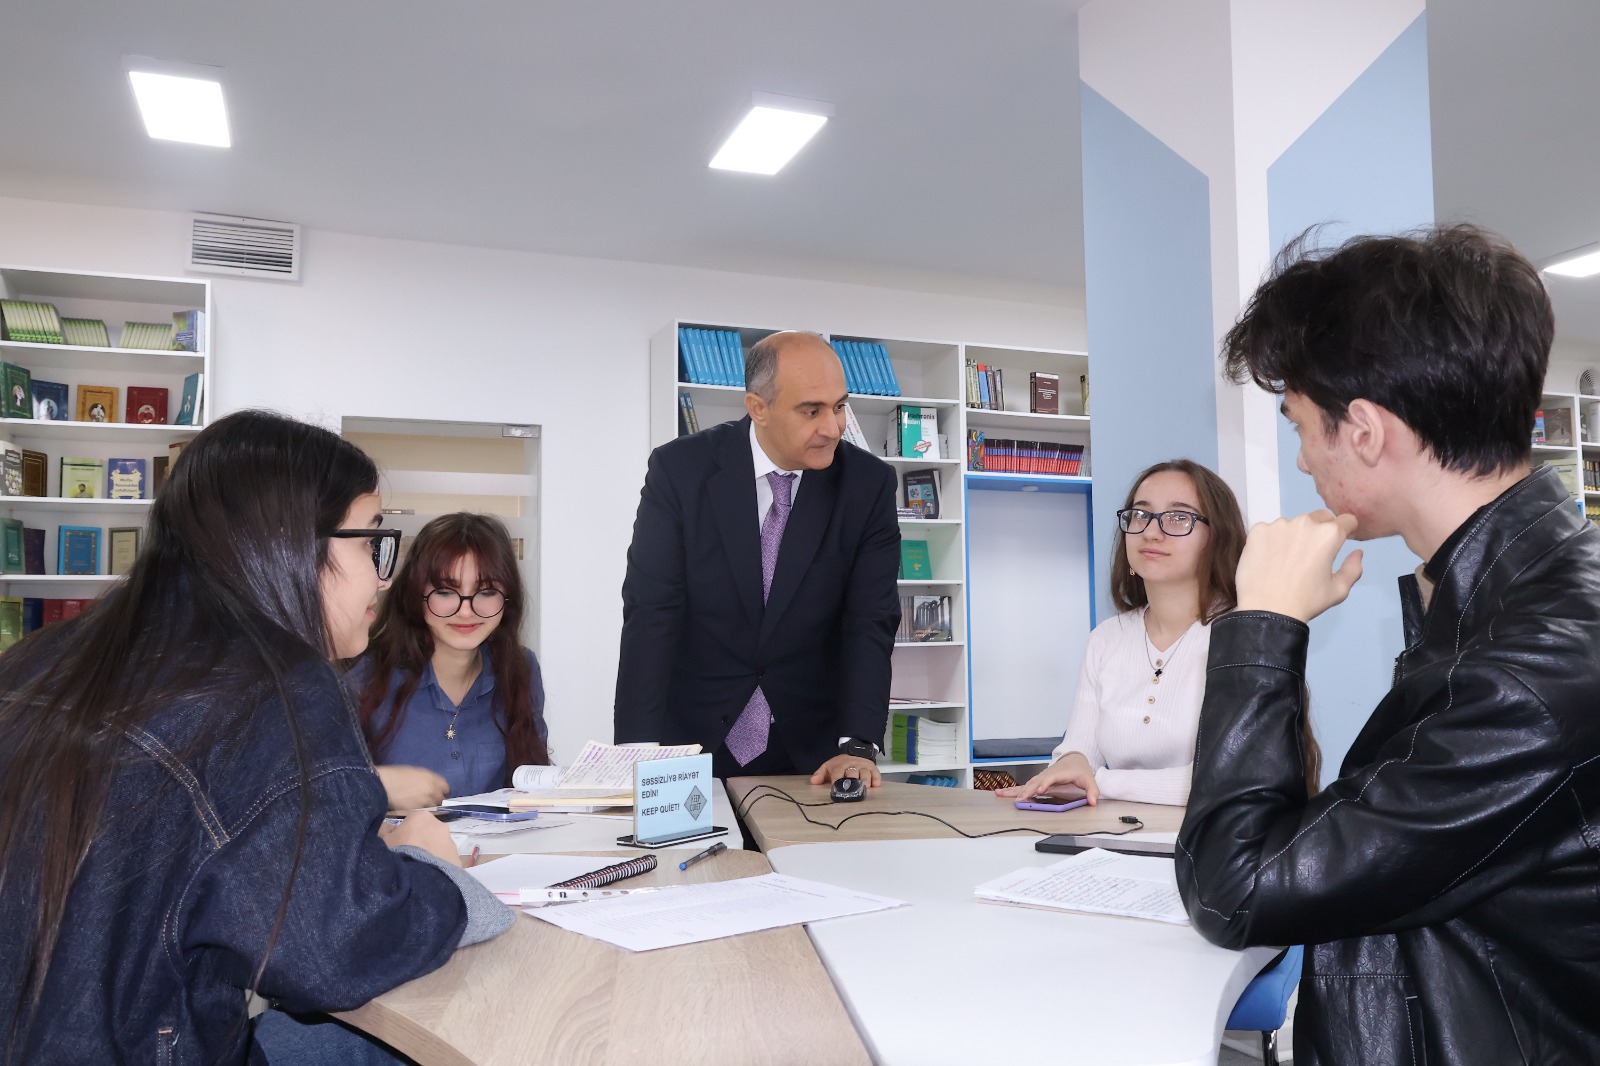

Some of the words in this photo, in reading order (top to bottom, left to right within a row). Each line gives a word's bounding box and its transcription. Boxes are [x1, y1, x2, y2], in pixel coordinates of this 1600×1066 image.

[642, 774, 676, 786] SƏSSİZLİYƏ
[678, 771, 699, 780] RİAYƏT
[642, 789, 658, 798] EDİN!
[642, 807, 658, 816] KEEP
